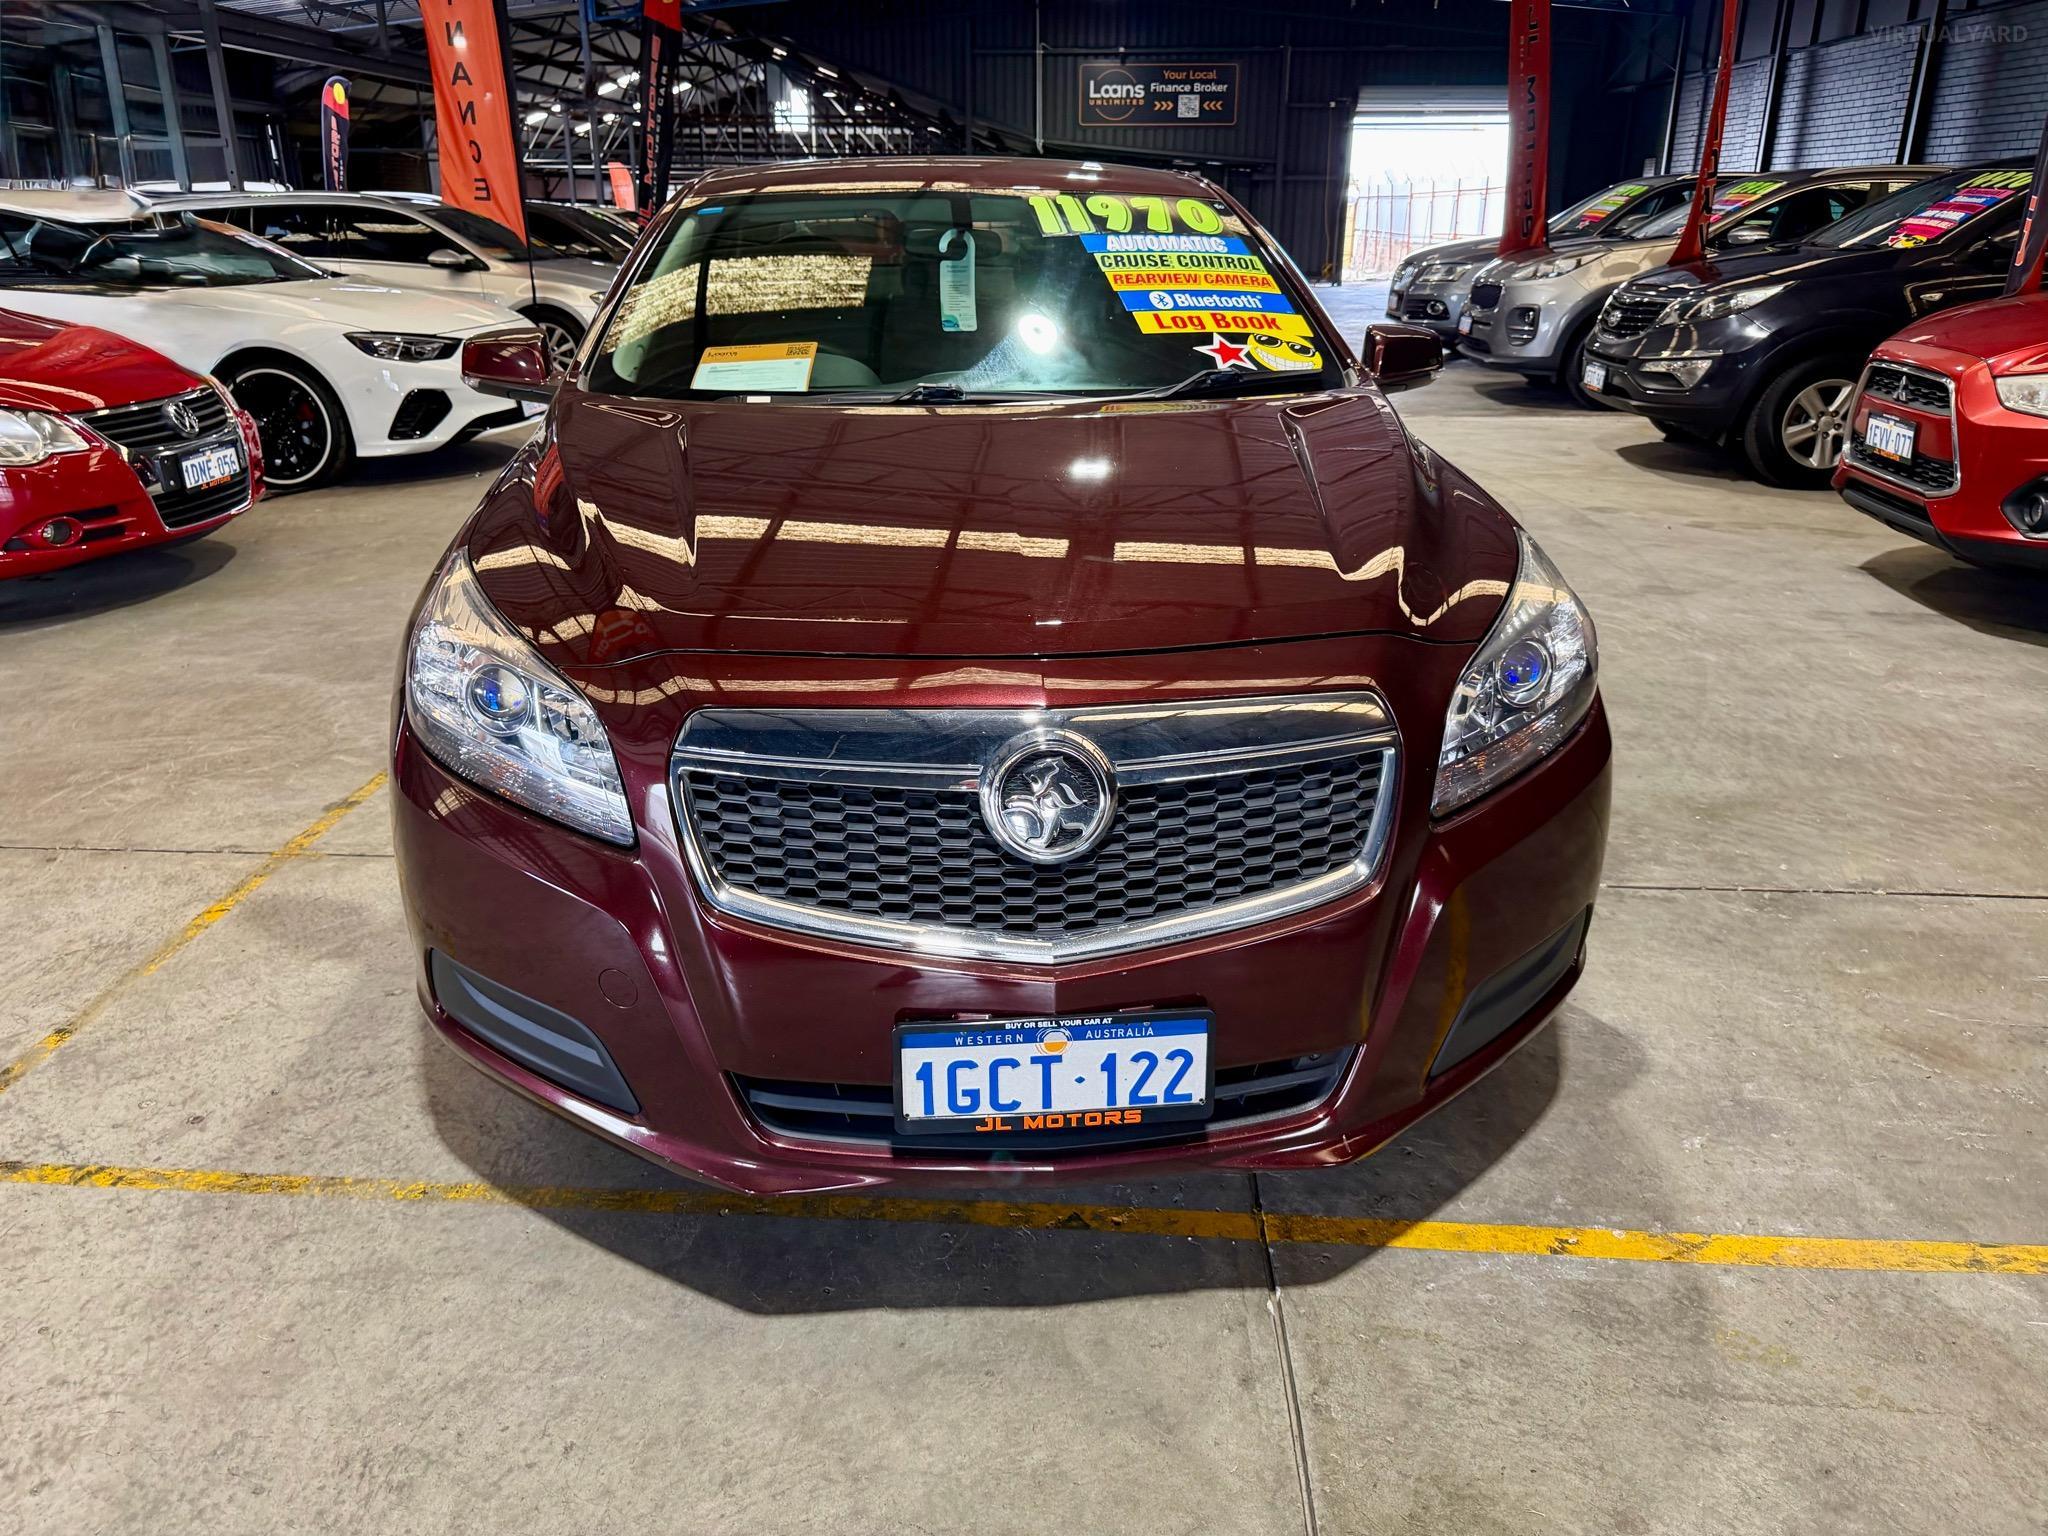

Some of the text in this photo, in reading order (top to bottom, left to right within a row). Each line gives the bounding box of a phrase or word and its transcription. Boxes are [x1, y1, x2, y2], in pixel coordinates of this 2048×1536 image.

[1163, 70, 1217, 79] Your Local
[1089, 80, 1145, 98] Loans
[1150, 83, 1228, 92] Finance Broker
[1029, 195, 1225, 235] 11970
[1106, 236, 1228, 253] AUTOMATIC
[1100, 254, 1261, 271] CRUISE CONTROL
[1113, 273, 1272, 287] REARVIEW CAMERA
[1153, 312, 1282, 330] Log Book
[1005, 1021, 1022, 1029] BUY
[1024, 1021, 1036, 1029] OR
[1037, 1020, 1058, 1028] SELL
[1058, 1019, 1083, 1027] YOUR
[1083, 1018, 1101, 1026] CAR
[954, 1027, 1154, 1046] WESTERN AUSTRALIA
[975, 1110, 1143, 1132] JL MOTORS
